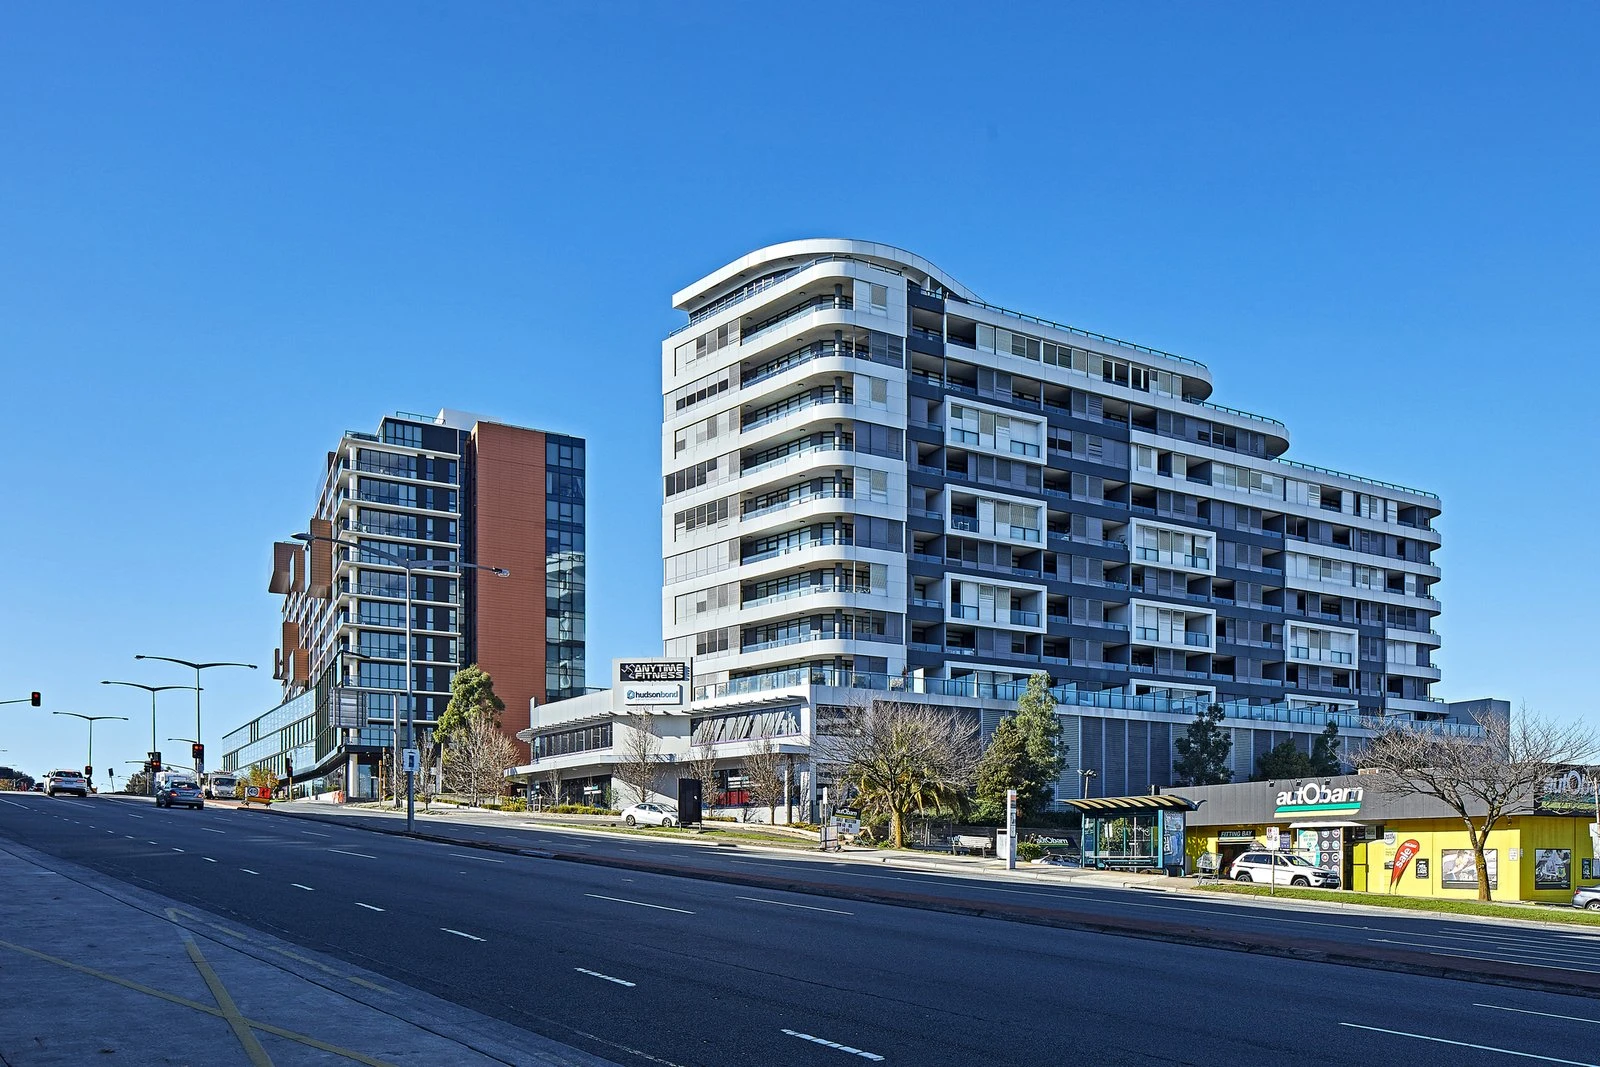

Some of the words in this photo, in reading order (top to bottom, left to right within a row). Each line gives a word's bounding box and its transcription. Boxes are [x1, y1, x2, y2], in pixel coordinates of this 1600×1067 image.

[634, 664, 684, 672] ANYTIME
[635, 690, 679, 699] hudsonbond
[1396, 847, 1413, 869] sale
